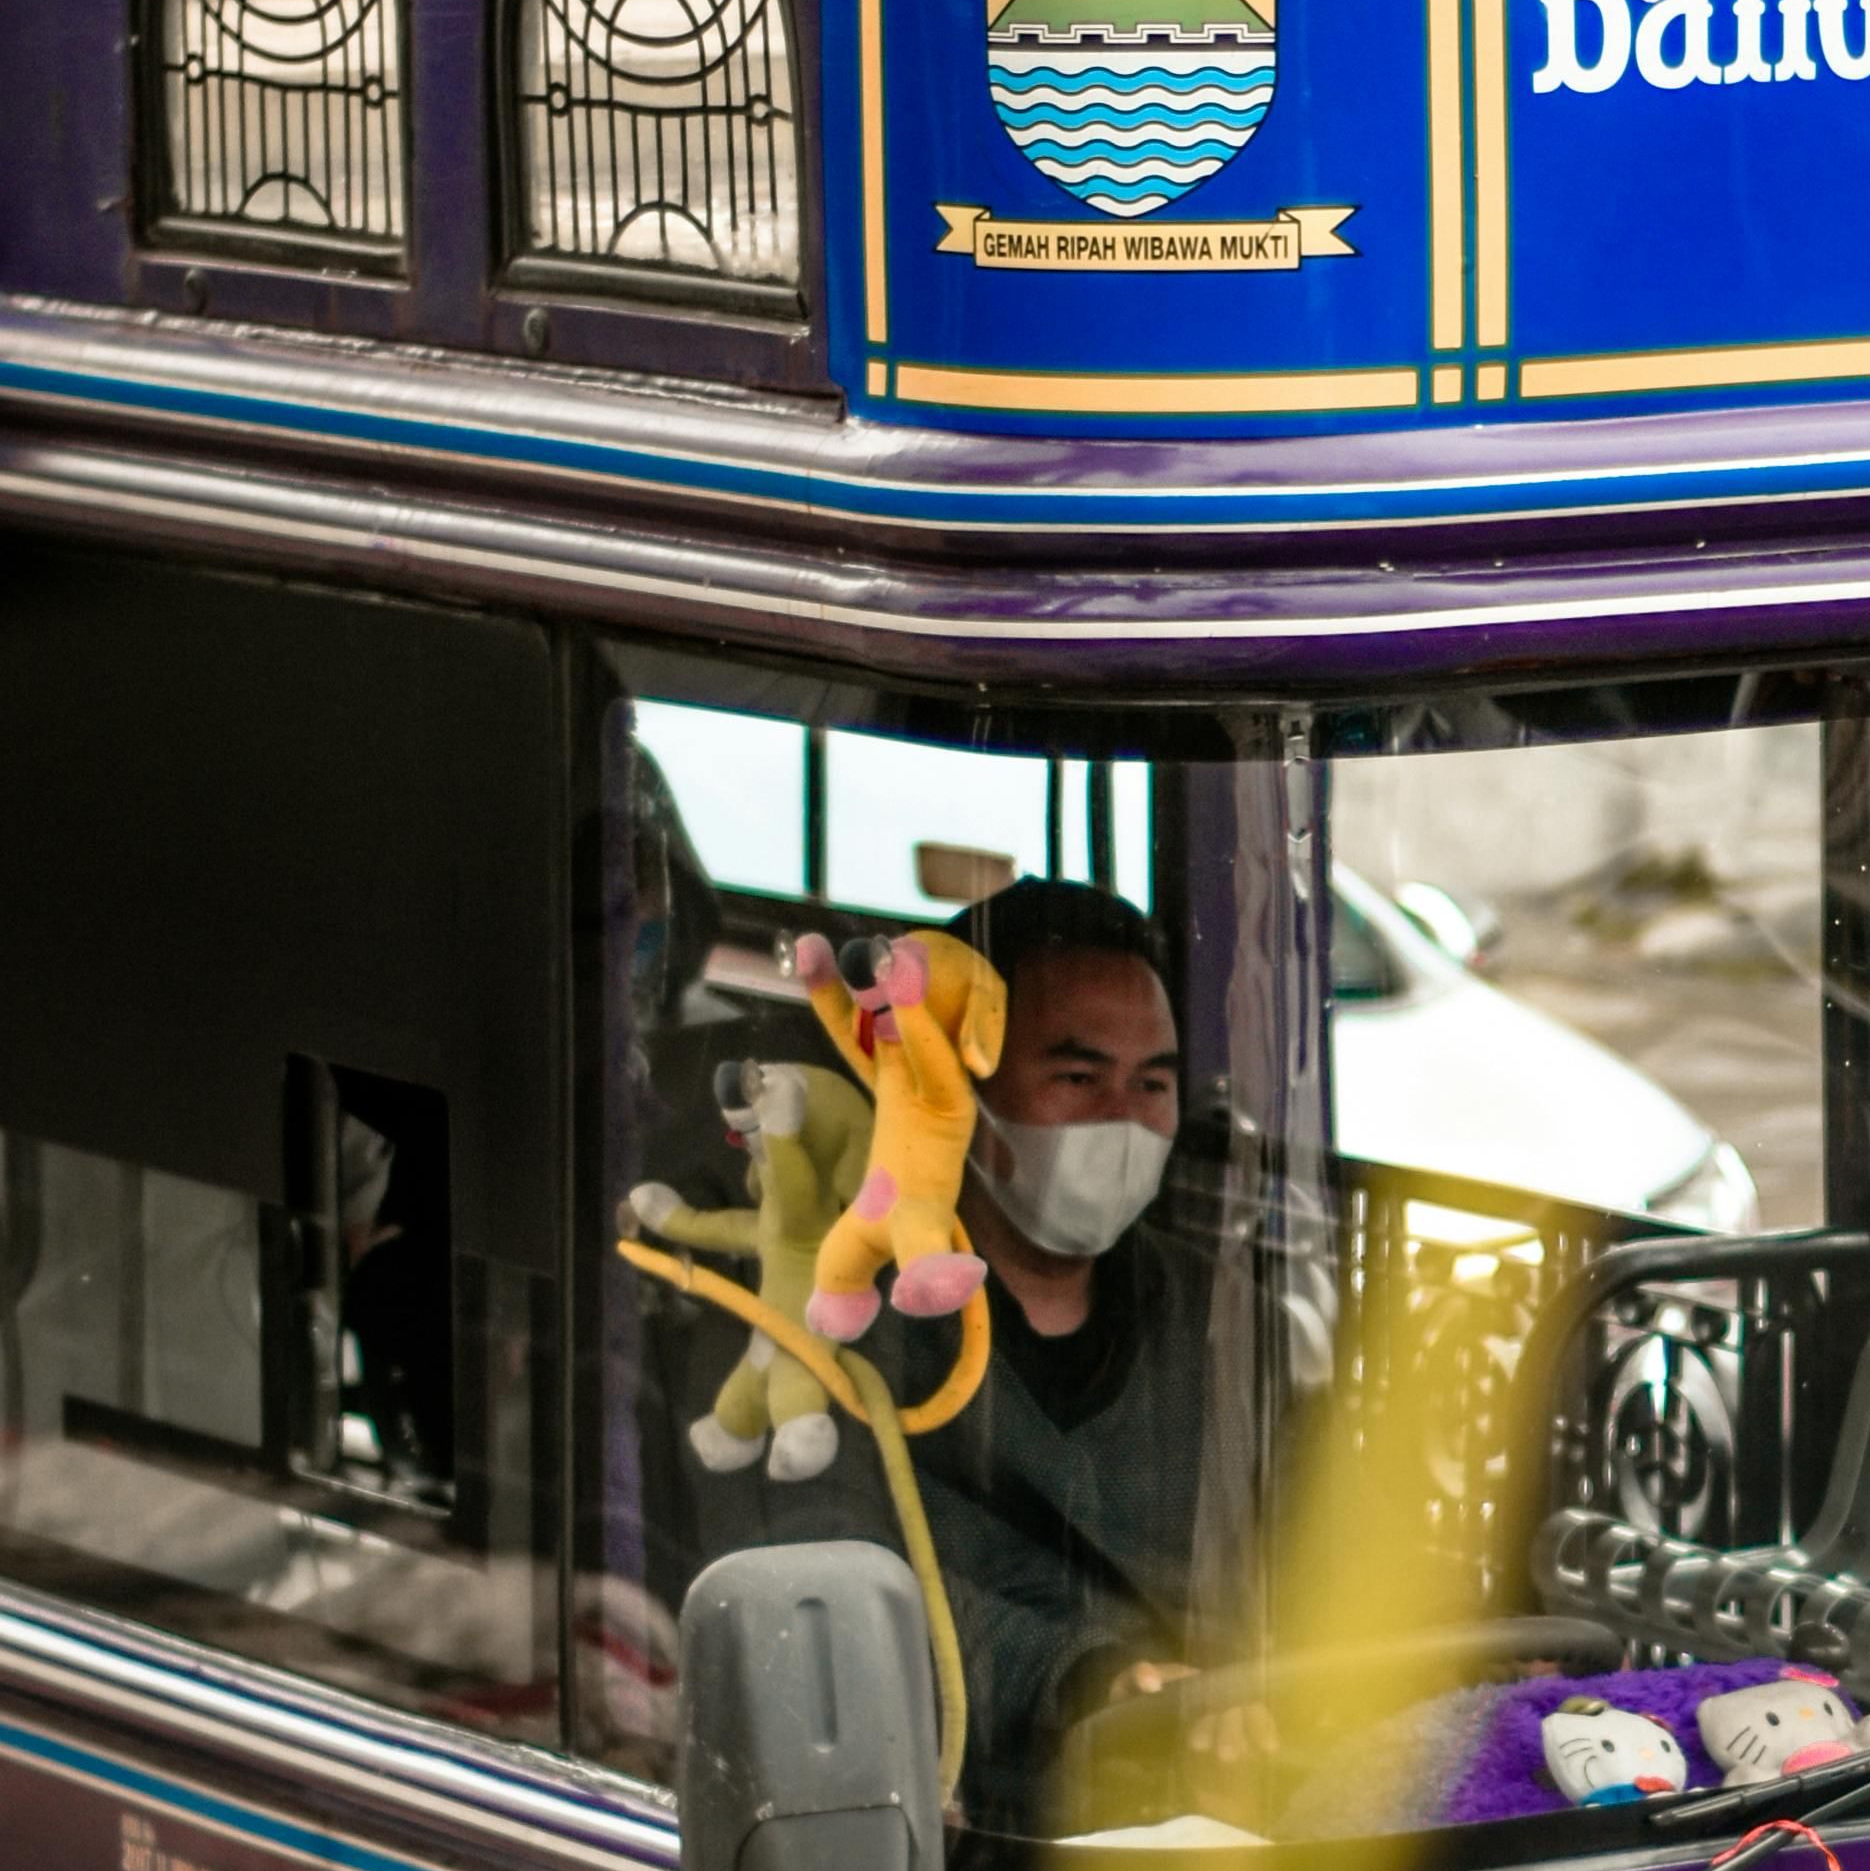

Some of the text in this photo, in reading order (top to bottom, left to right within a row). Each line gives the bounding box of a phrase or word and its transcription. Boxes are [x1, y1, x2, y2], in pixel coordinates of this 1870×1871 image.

[983, 232, 1289, 260] GEMAH RIPAH WIBAWA MUKTI
